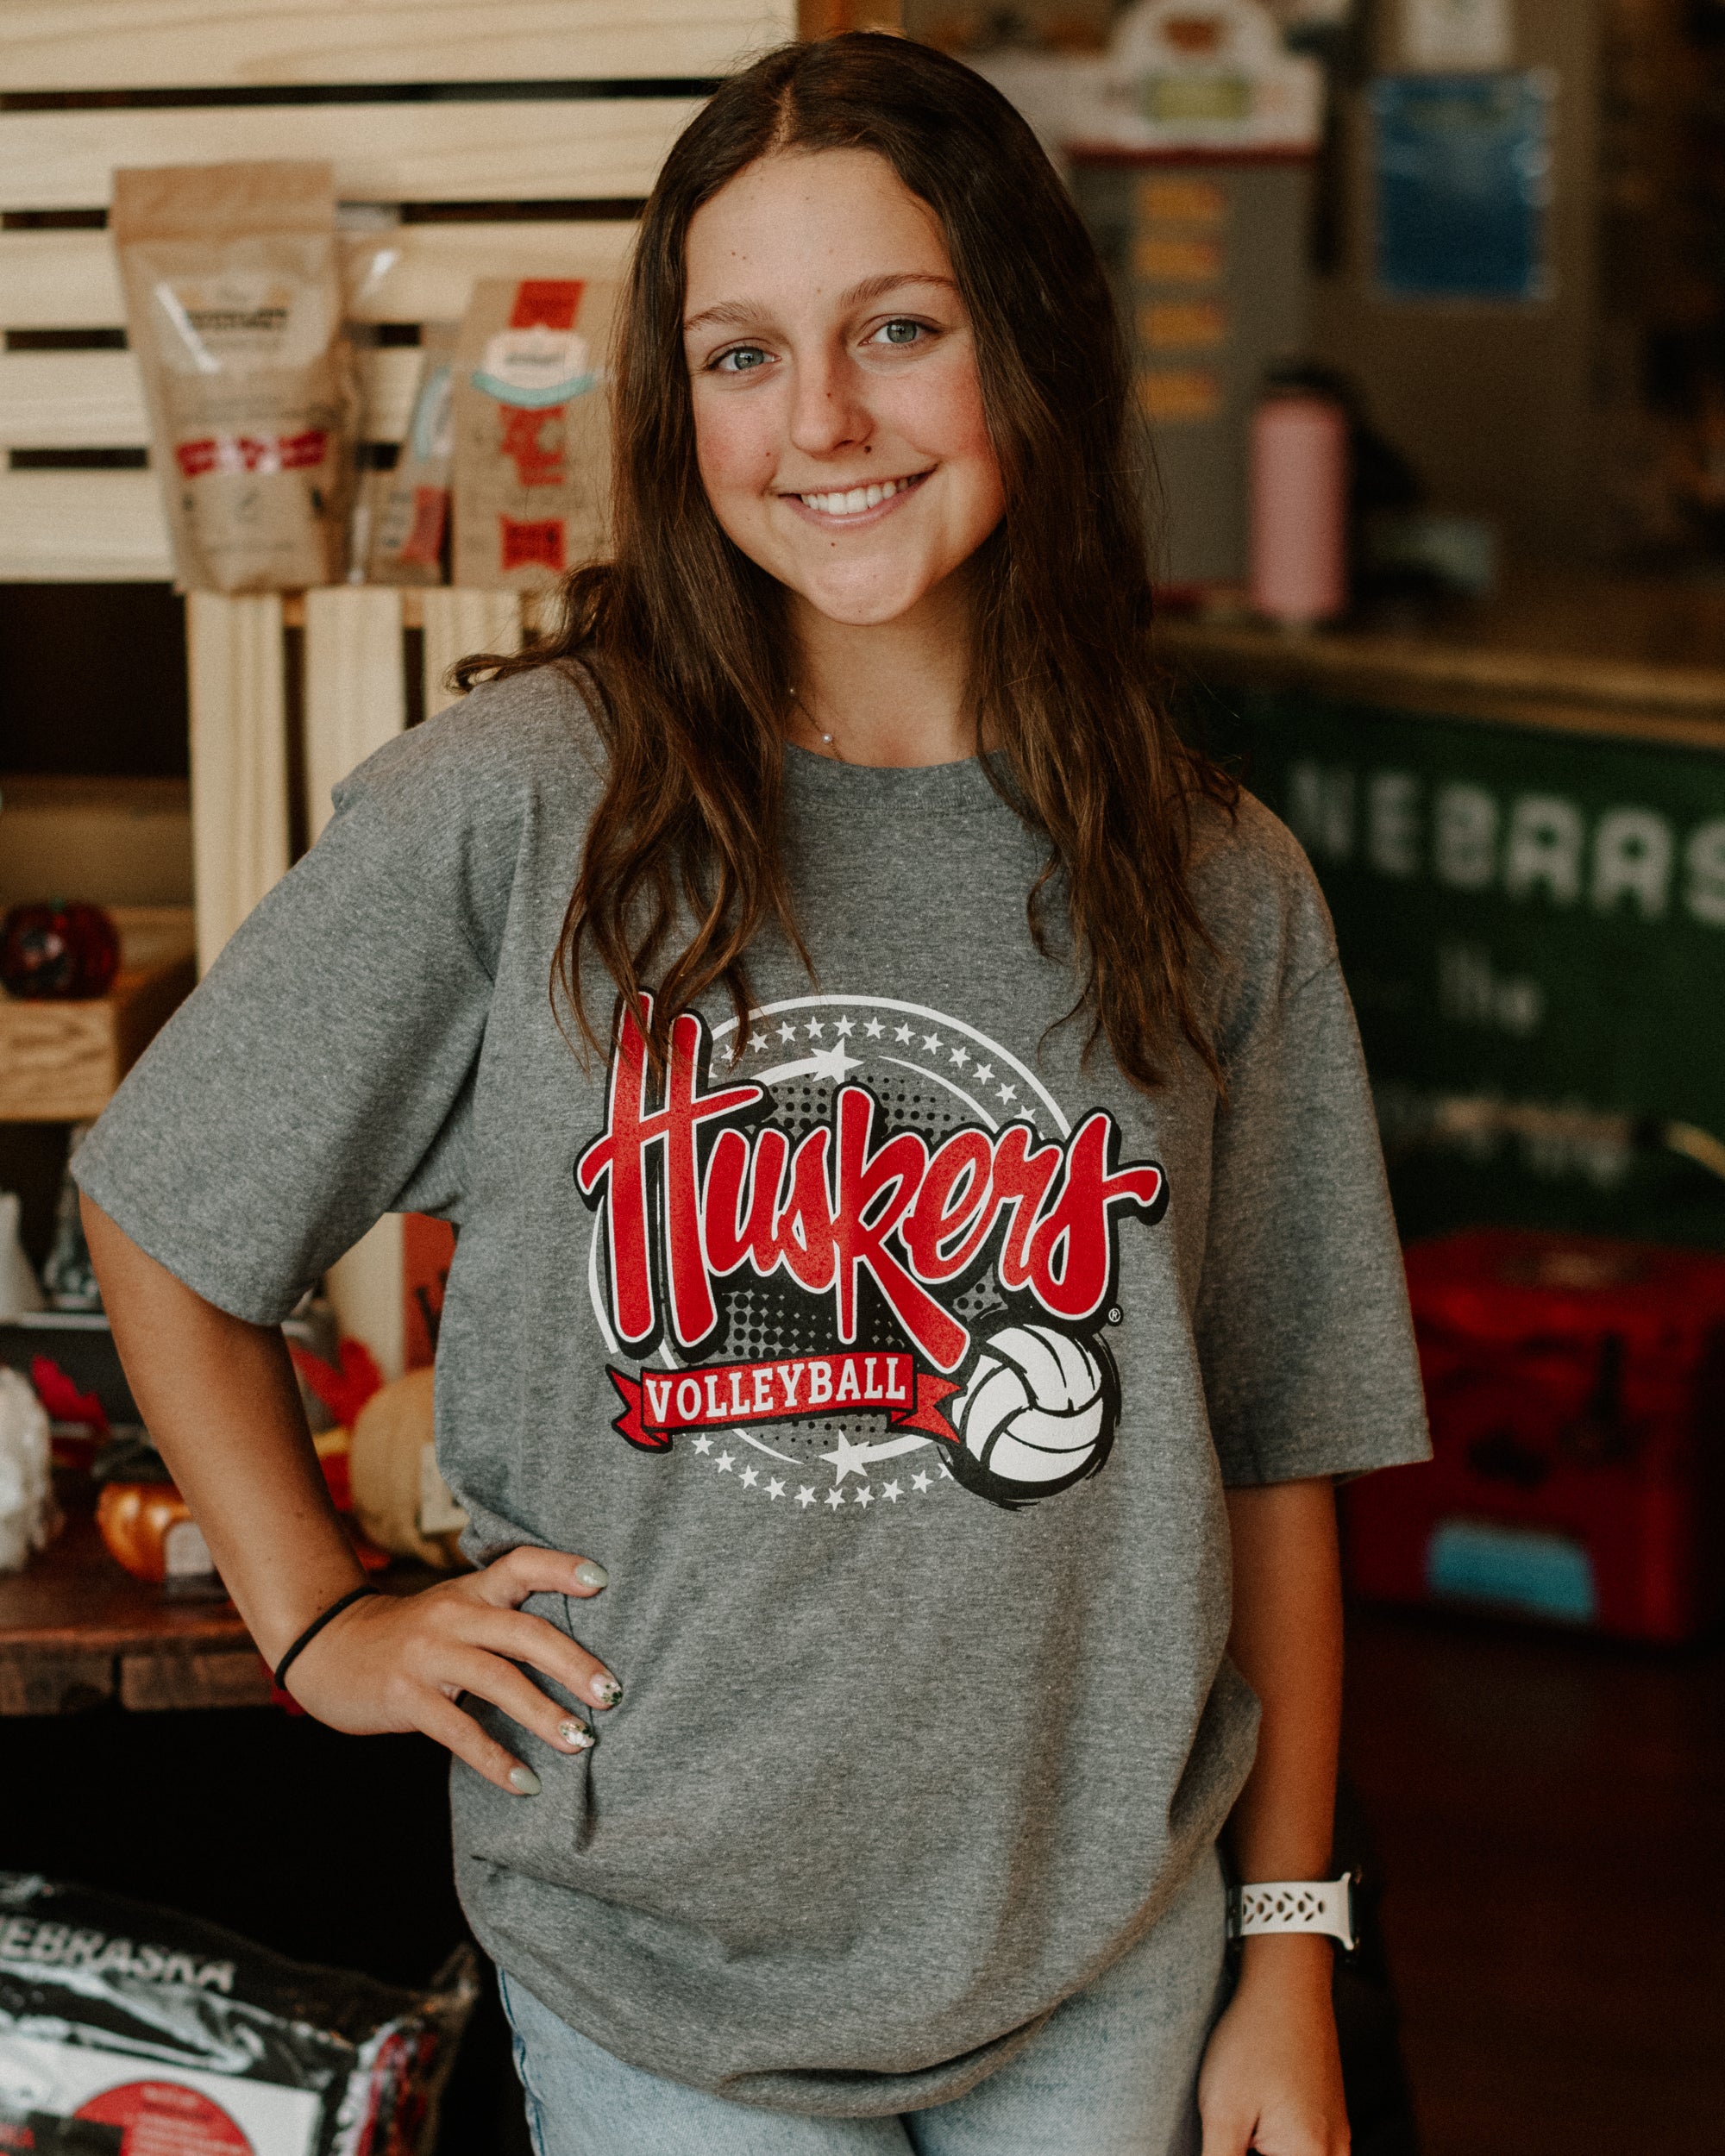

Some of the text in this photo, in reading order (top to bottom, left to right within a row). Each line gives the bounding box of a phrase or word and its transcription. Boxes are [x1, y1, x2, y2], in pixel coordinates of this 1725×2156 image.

[577, 992, 1164, 1373] Huskers
[645, 1357, 906, 1424] VOLLEYBALL
[0, 1915, 235, 1991] EBRASKA
